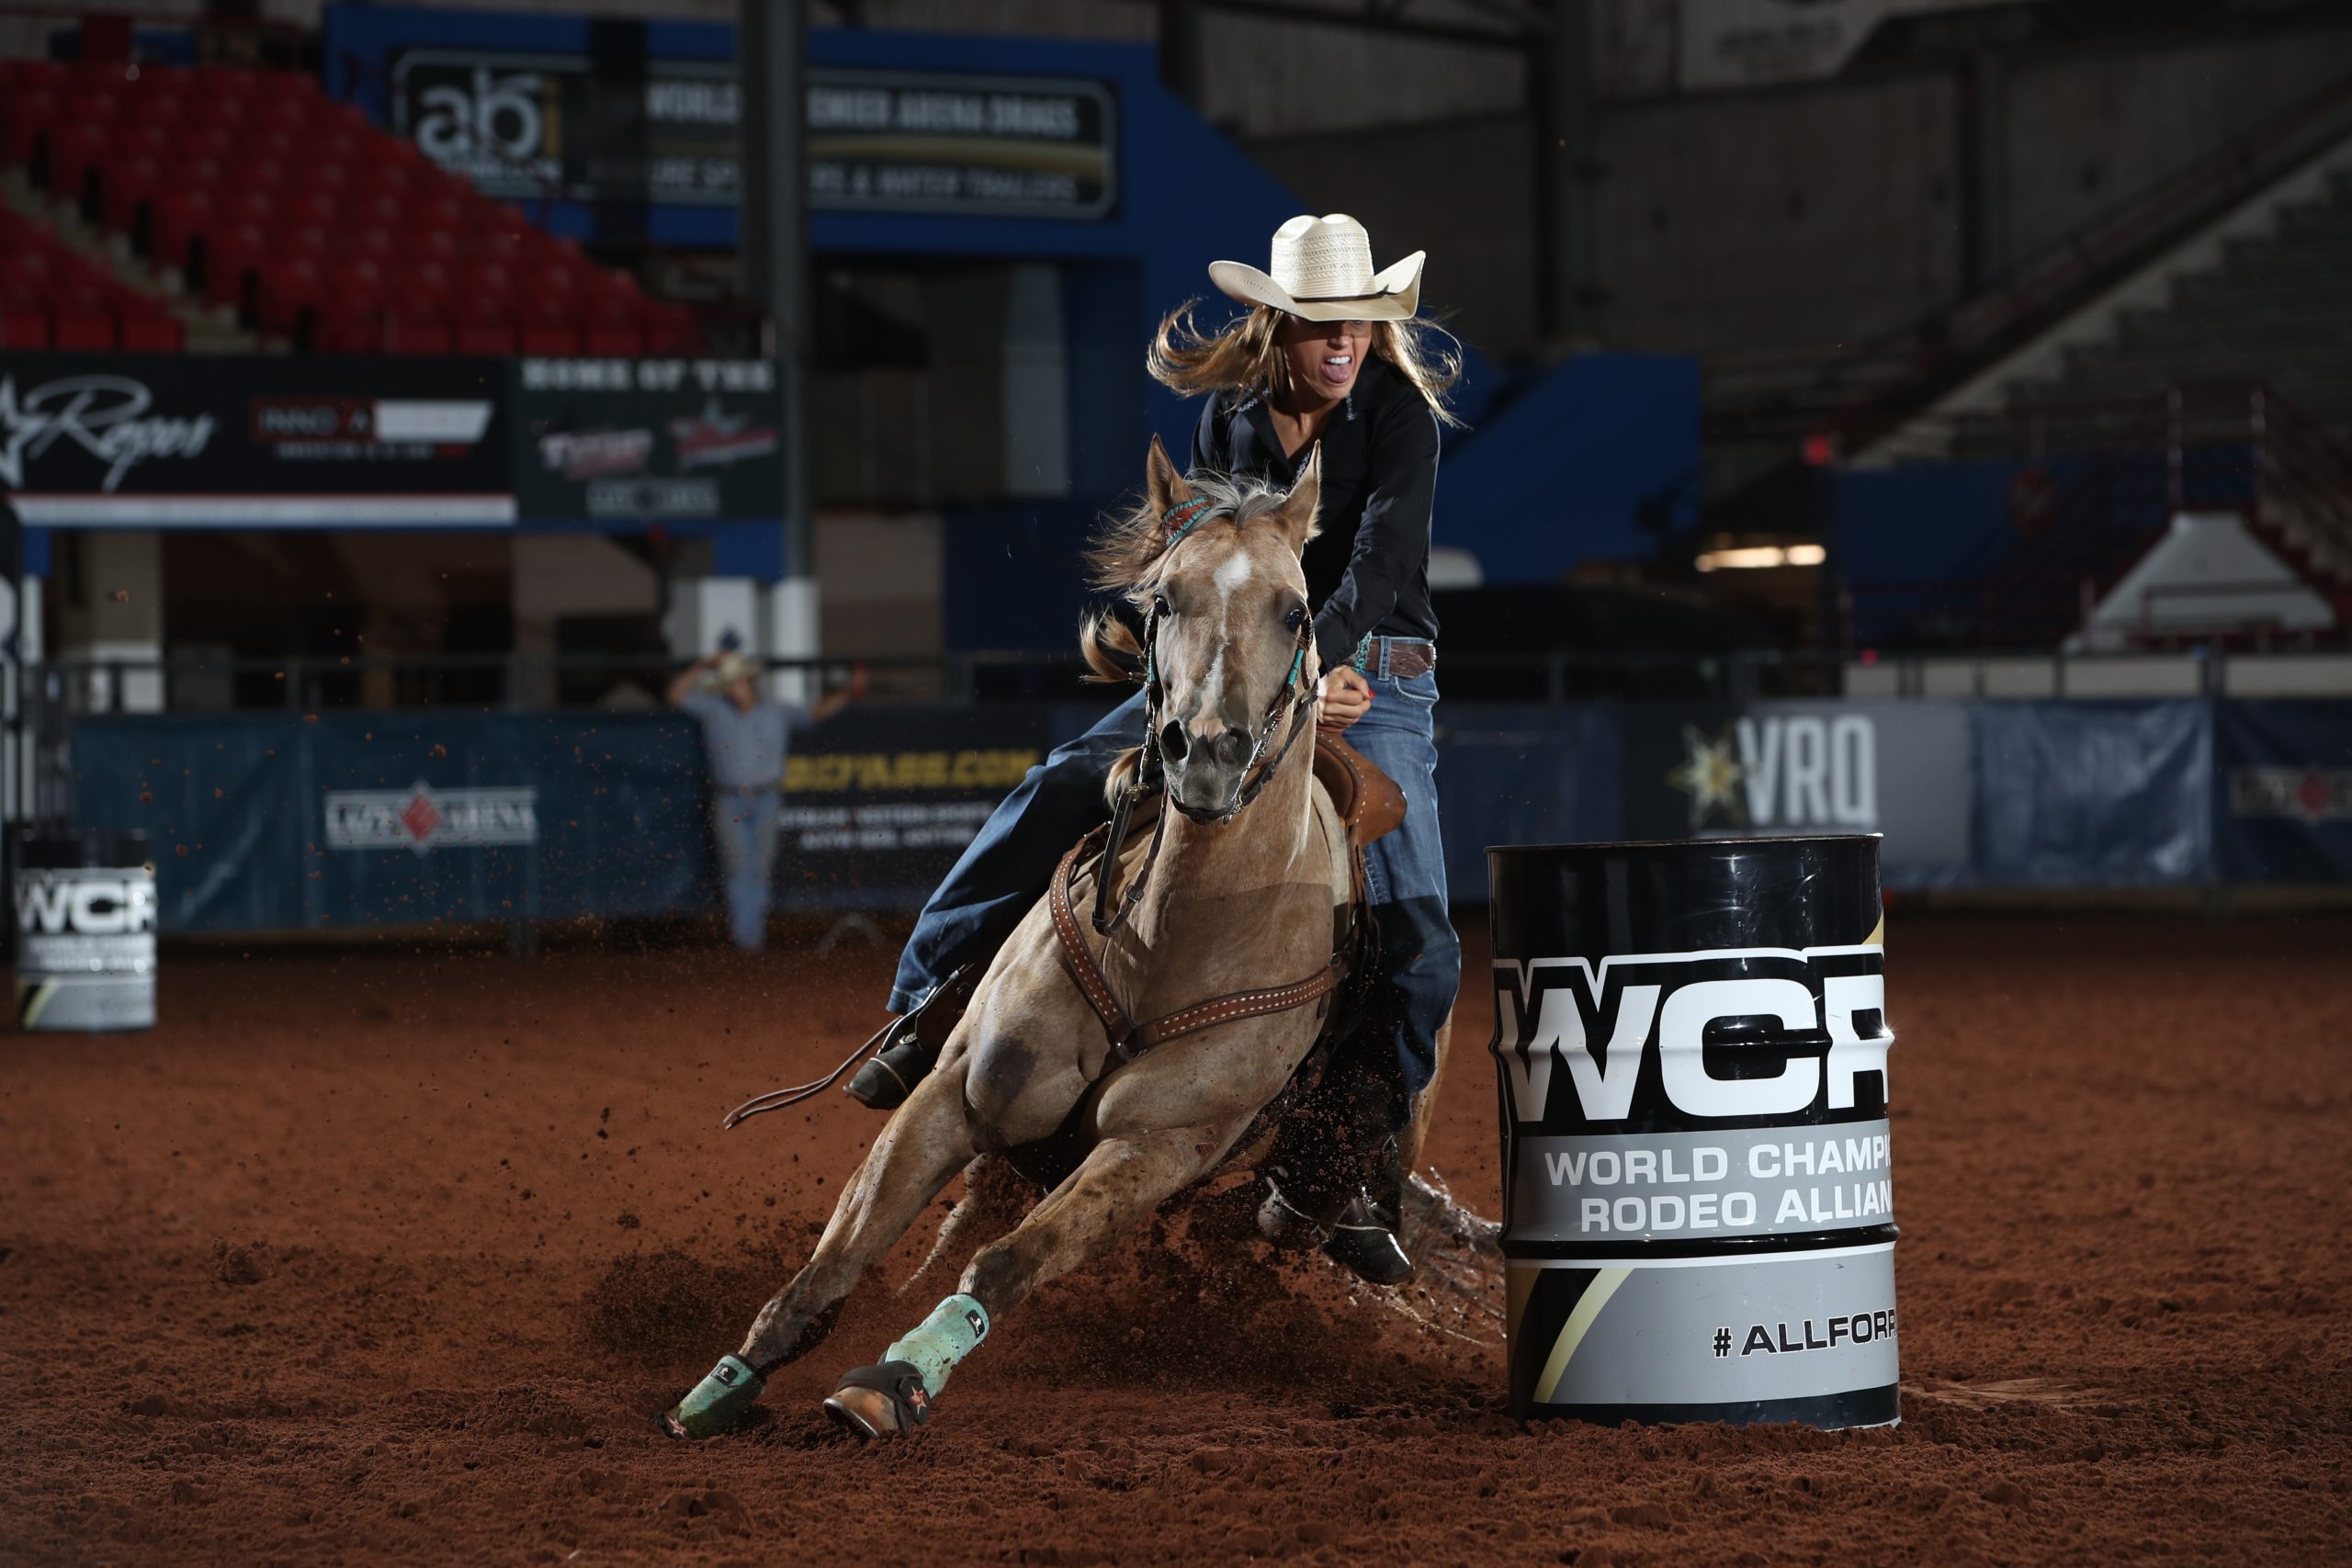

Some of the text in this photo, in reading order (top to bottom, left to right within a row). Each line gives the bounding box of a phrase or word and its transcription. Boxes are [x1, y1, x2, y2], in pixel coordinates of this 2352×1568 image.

[522, 357, 776, 393] HOME OF THE
[1736, 714, 1880, 825] VRQ
[1497, 974, 1894, 1122] WCR
[1544, 1146, 1728, 1186] WORLD
[1581, 1180, 1893, 1233] RODEO ALLIAN
